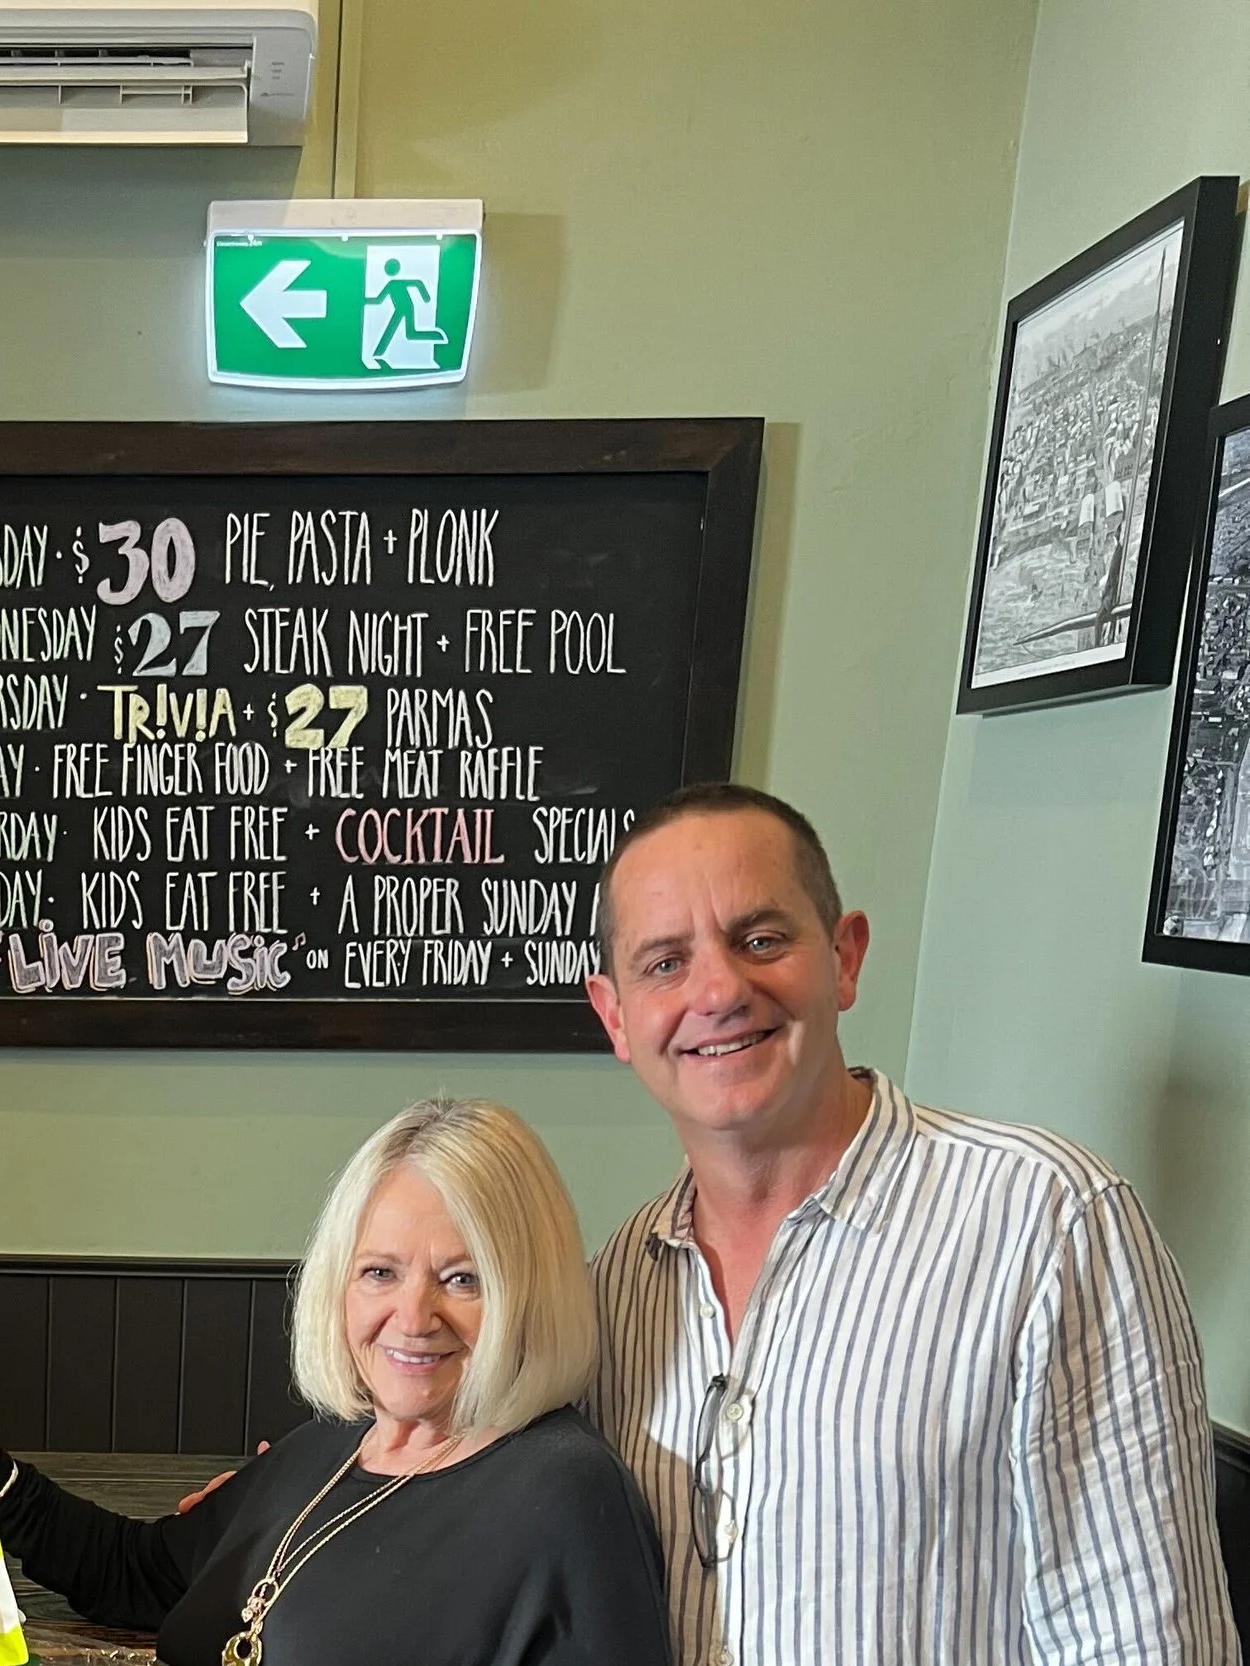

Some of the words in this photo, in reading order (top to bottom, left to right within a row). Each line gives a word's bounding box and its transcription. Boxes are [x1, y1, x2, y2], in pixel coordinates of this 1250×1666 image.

[288, 510, 371, 586] PASTA
[407, 508, 499, 588] PLONK
[244, 607, 335, 678] STEAK
[348, 609, 429, 678] NIGHT
[465, 609, 537, 674] FREE
[550, 609, 627, 675] POOL
[386, 687, 494, 750] PARMAS
[53, 743, 114, 799] FREE
[122, 742, 204, 799] FINGER
[214, 742, 270, 797] FOOD
[308, 746, 364, 799] FREE
[382, 748, 444, 800] MEAT
[458, 746, 545, 801] RAFFLE
[93, 806, 152, 863] KIDS
[166, 806, 216, 862] EAT
[229, 806, 289, 862] FREE
[335, 807, 505, 865] COCKTAIL
[81, 871, 144, 930] KIDS
[165, 871, 218, 932] EAT
[228, 870, 289, 934] FREE
[338, 874, 360, 936] A
[372, 874, 464, 937] PROPER
[481, 876, 577, 938] SUNDAY
[306, 949, 329, 970] ON
[344, 938, 412, 989] EVERY
[422, 938, 493, 986] FRIDAY
